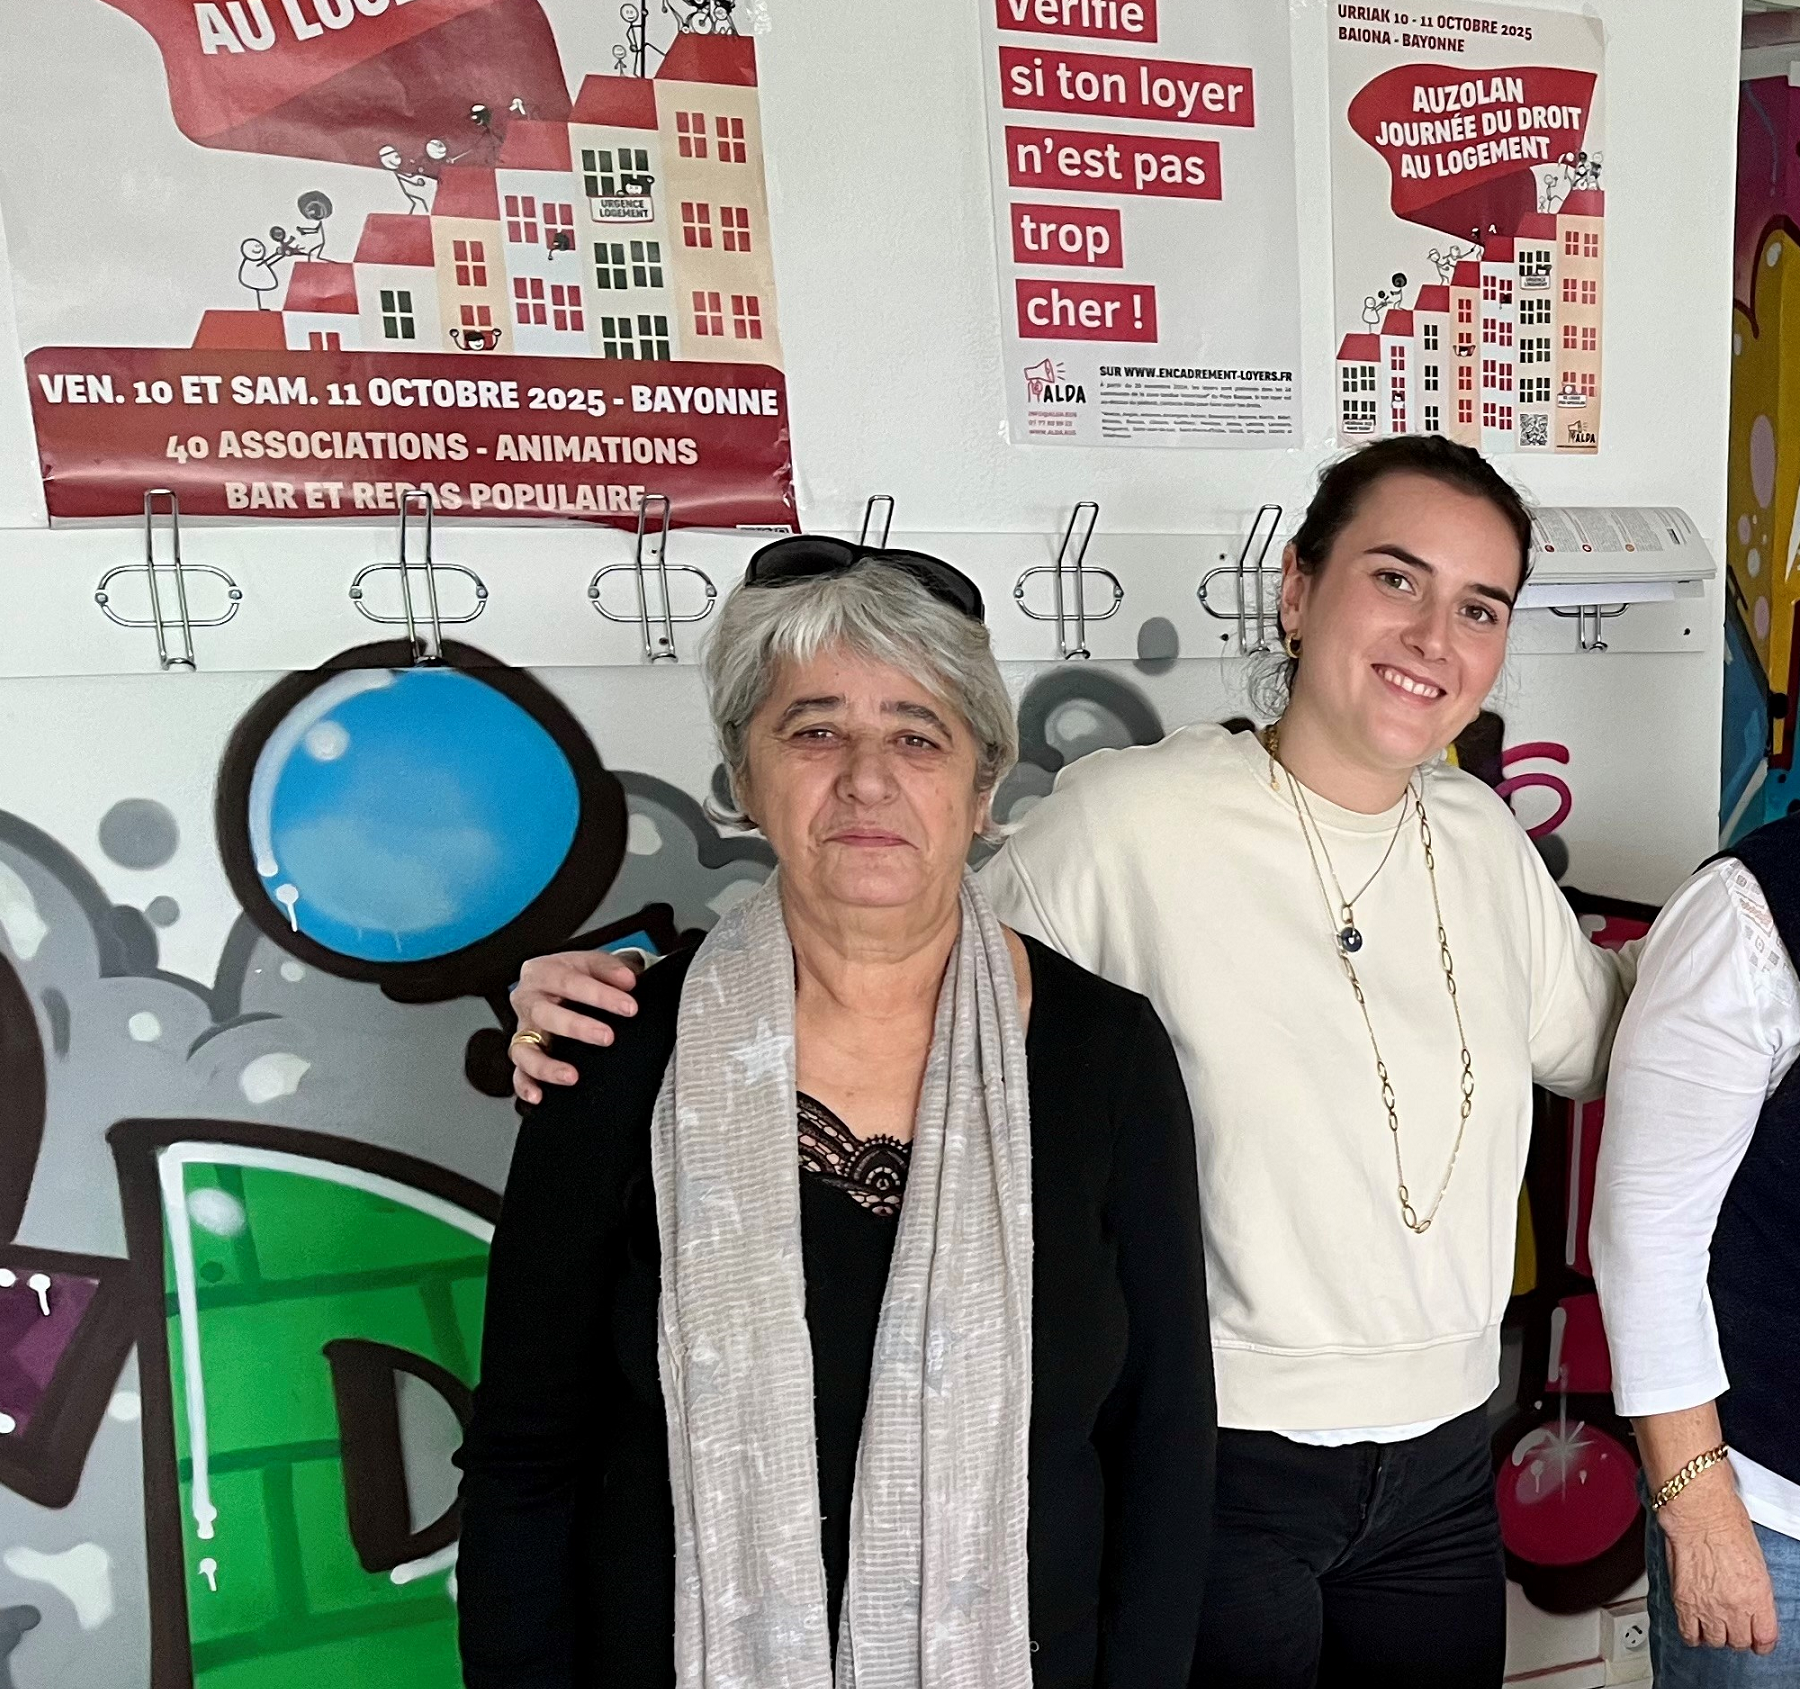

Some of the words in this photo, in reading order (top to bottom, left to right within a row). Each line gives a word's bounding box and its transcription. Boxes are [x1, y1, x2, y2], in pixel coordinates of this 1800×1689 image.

[193, 0, 276, 55] AU
[1337, 4, 1391, 24] URRIAK
[1394, 13, 1409, 25] 10
[1420, 16, 1434, 28] 11
[1437, 15, 1499, 34] OCTOBRE
[1501, 24, 1533, 41] 2025
[1338, 26, 1392, 45] BAIONA
[1402, 33, 1466, 52] BAYONNE
[1010, 58, 1045, 97] si
[1056, 62, 1127, 104] ton
[1140, 66, 1244, 118] loyer
[1412, 77, 1525, 114] AUZOLAN
[1375, 113, 1478, 147] JOURNÉE
[1481, 108, 1513, 137] DU
[1516, 105, 1582, 131] DROIT
[1133, 152, 1207, 190] pas
[1400, 153, 1432, 180] AU
[1435, 135, 1551, 178] LOGEMENT
[599, 208, 649, 218] LOGEMENT
[600, 199, 645, 208] URGENCE
[1020, 214, 1111, 262] trop
[1026, 288, 1121, 328] cher
[1132, 294, 1144, 329] !
[1099, 366, 1122, 378] SUR
[1124, 366, 1293, 382] WWW.ENCADREMENT-LOYERS.FR
[38, 374, 126, 405] VEN.
[133, 381, 173, 404] 10
[181, 375, 222, 405] ET
[230, 376, 319, 406] SAM.
[326, 382, 362, 406] 11
[368, 377, 520, 409] OCTOBRE
[527, 387, 607, 417] 2025
[630, 385, 779, 416] BAYONNE
[1043, 385, 1087, 403] ALDA
[166, 434, 210, 464] 40
[218, 430, 470, 462] ASSOCIATIONS
[496, 434, 700, 466] ANIMATIONS
[225, 482, 299, 510] BAR
[304, 482, 344, 510] ET
[470, 483, 648, 512] POPULAIRE
